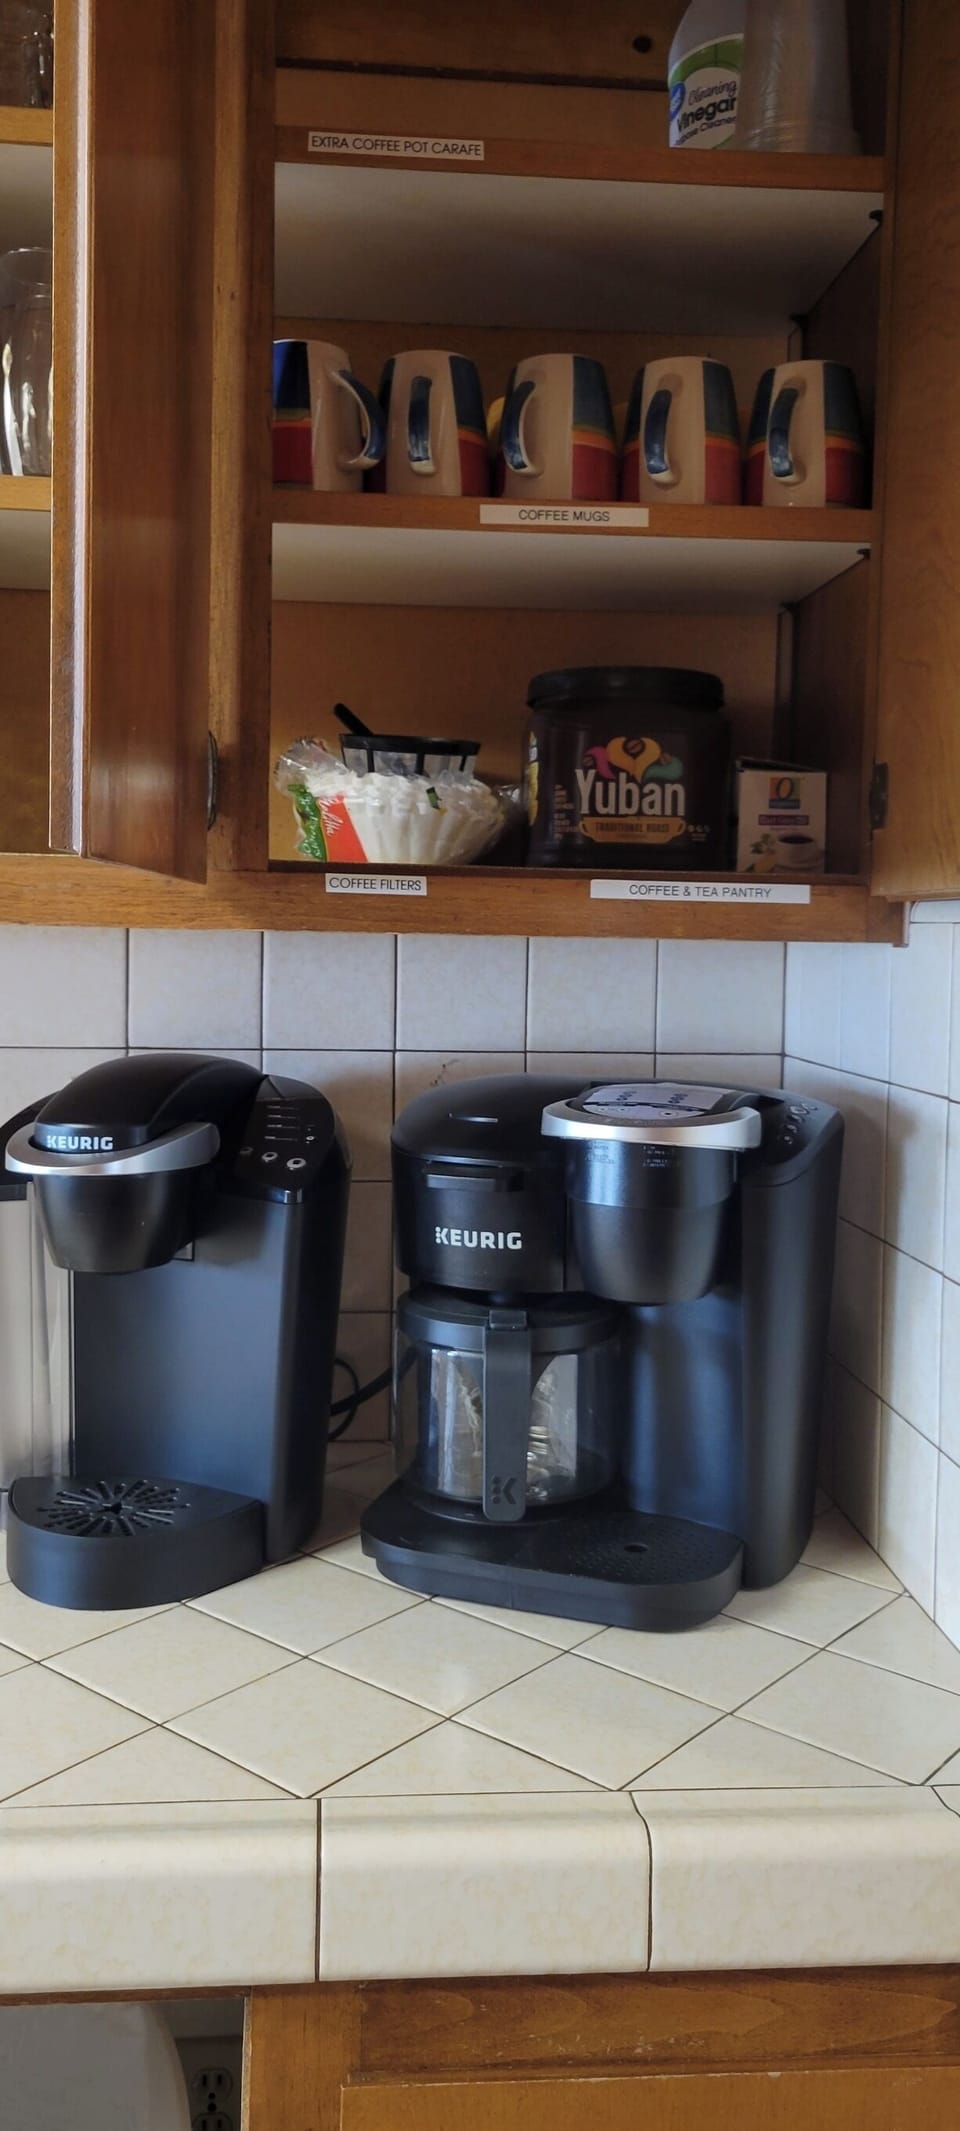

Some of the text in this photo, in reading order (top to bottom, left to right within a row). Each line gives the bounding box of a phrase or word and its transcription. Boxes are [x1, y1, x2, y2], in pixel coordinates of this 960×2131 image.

[688, 80, 737, 106] Cleaning
[676, 97, 737, 133] Vinegar
[311, 135, 481, 156] EXTRA COFFEE POT CARAFE
[518, 509, 610, 522] COFFEE MUGS
[575, 768, 686, 817] Yuban
[328, 876, 422, 892] COFFEE FILTERS
[628, 884, 772, 899] COFFEE & TEA PANTRY
[46, 1135, 114, 1151] KEURIG
[434, 1226, 523, 1250] KEURIG
